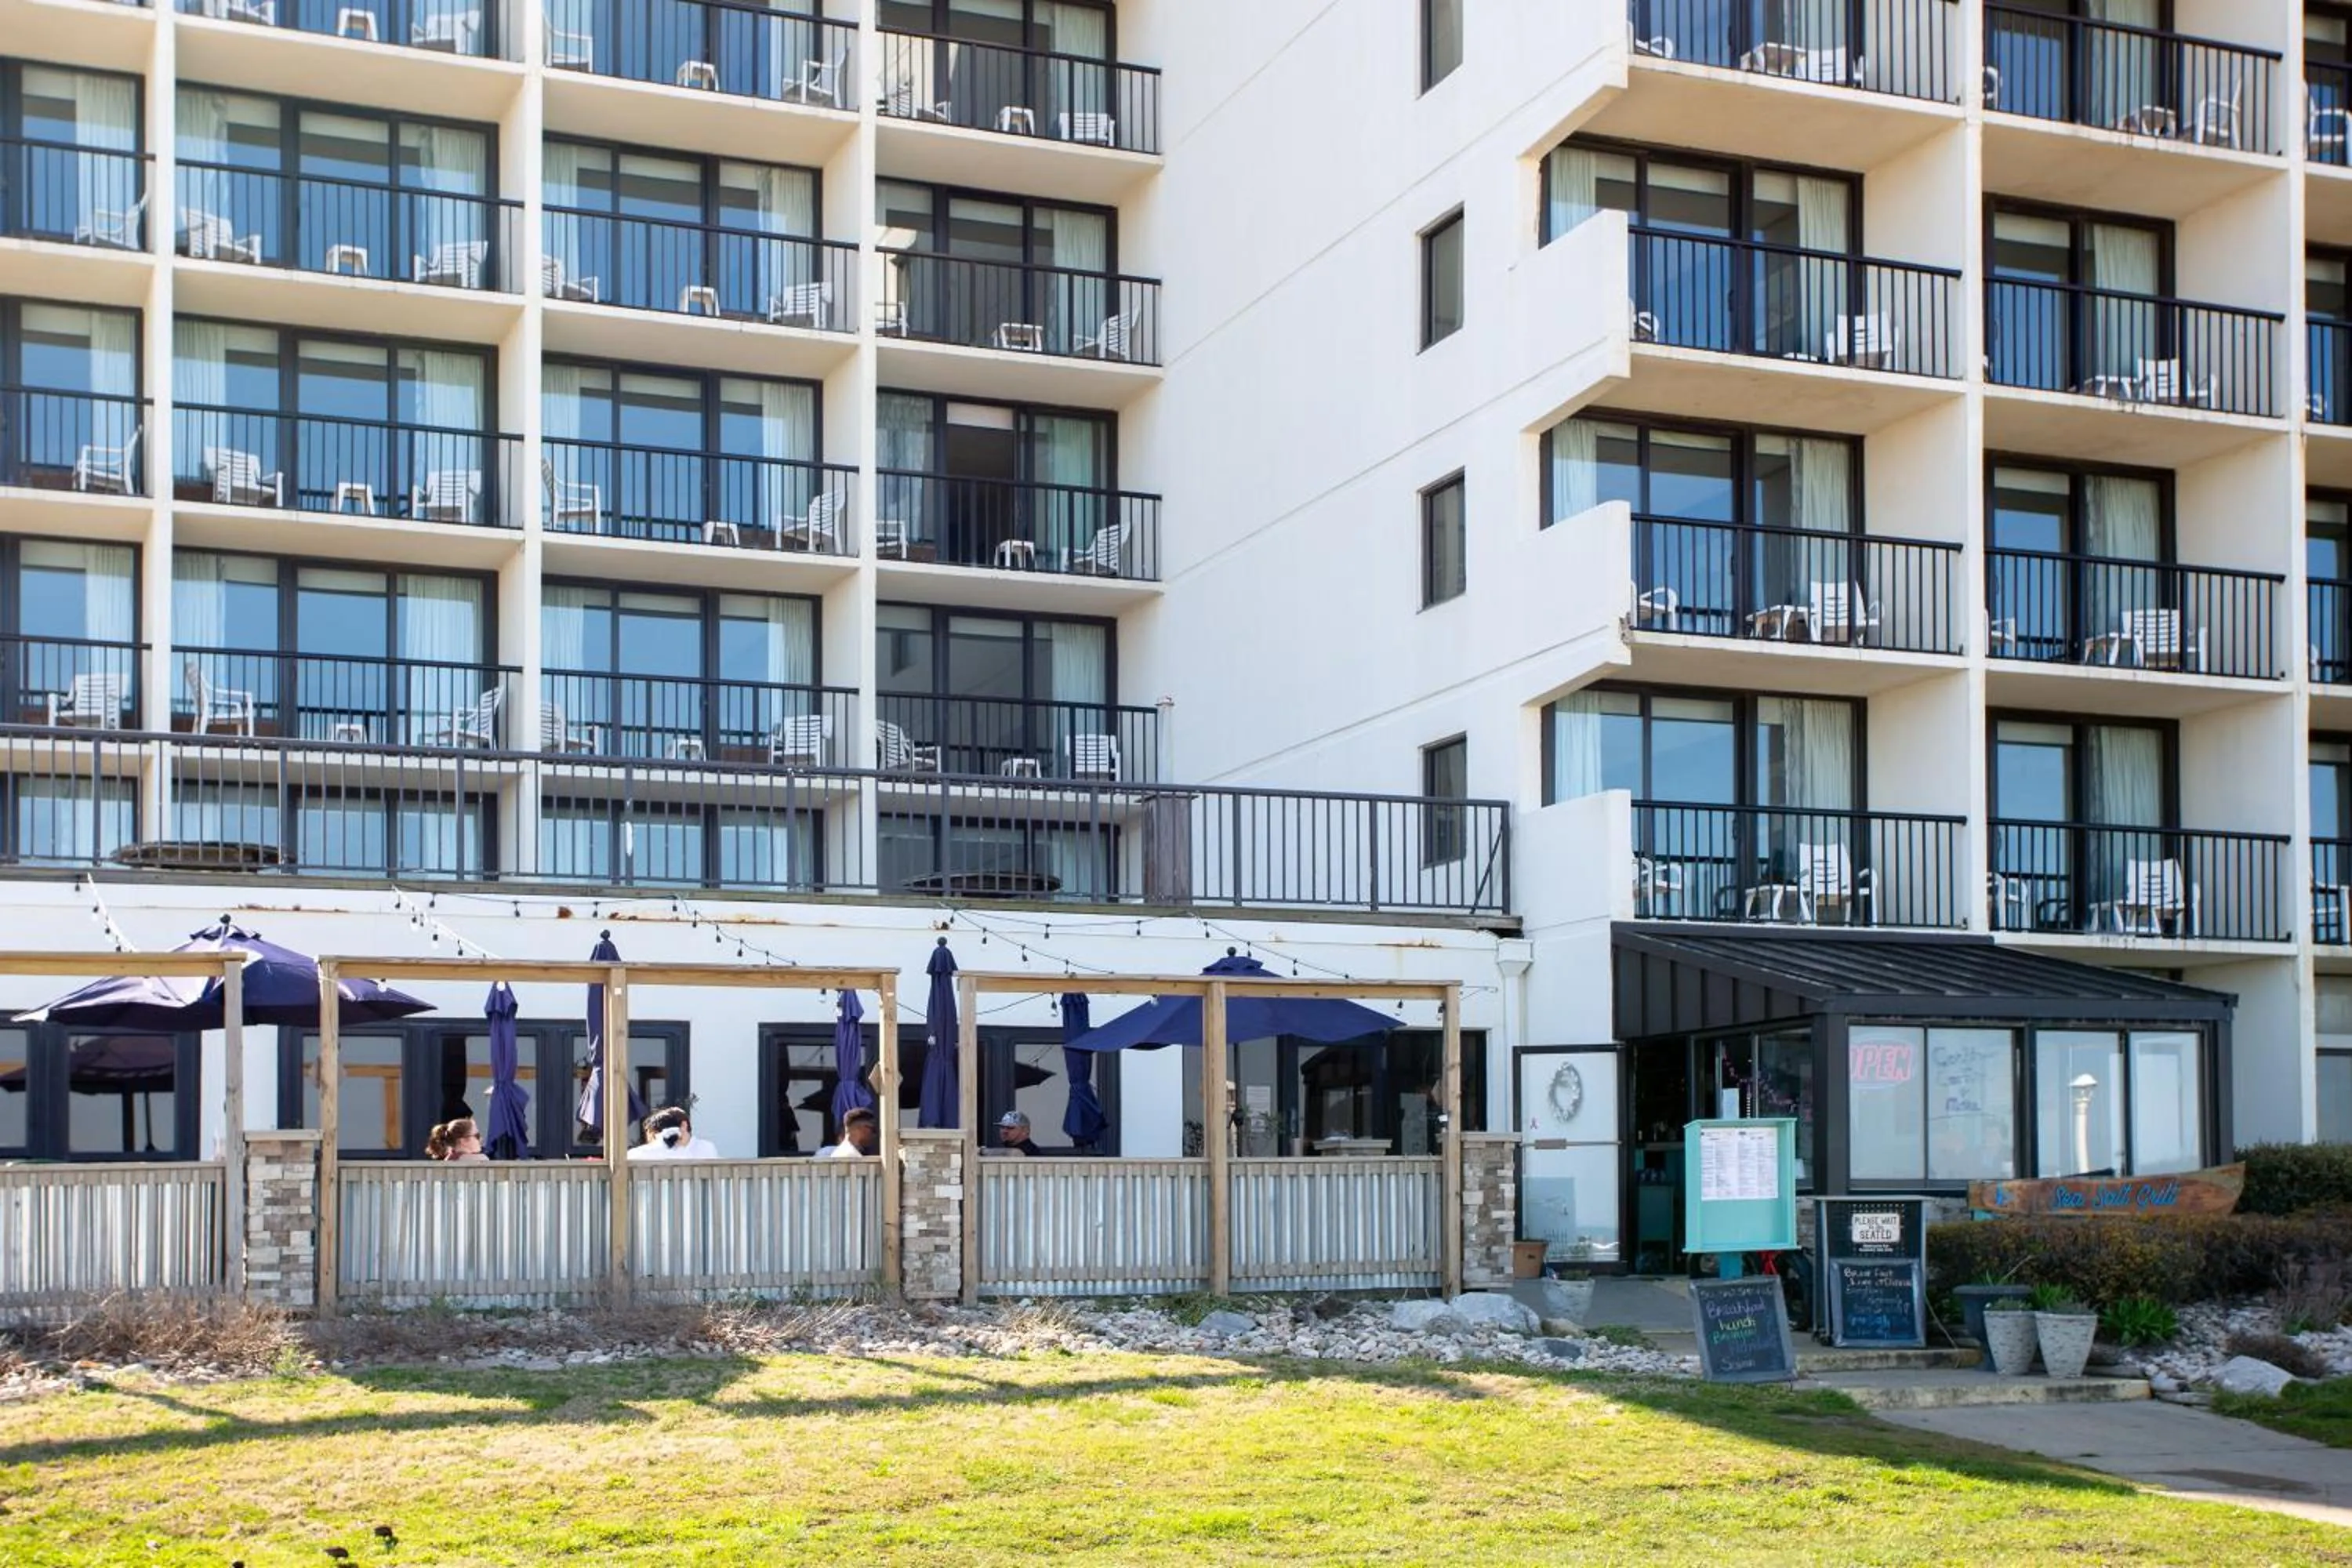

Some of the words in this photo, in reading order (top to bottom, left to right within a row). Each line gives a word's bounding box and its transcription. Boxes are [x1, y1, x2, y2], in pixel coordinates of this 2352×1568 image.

[2055, 1185, 2086, 1208] Sea
[1854, 1216, 1879, 1225] PLEASE
[1881, 1216, 1897, 1225] WAIT
[1859, 1229, 1893, 1240] SEATED
